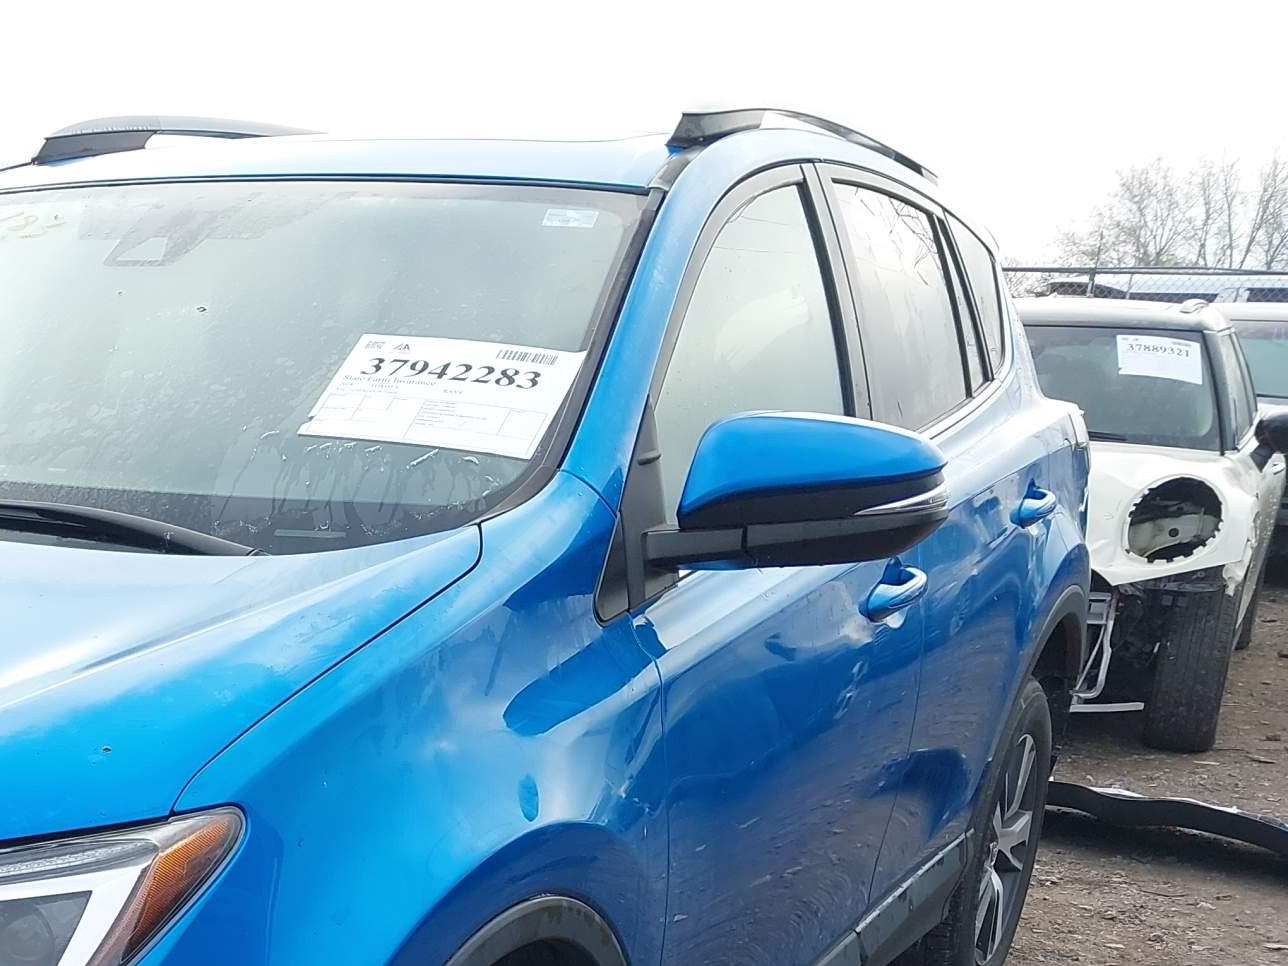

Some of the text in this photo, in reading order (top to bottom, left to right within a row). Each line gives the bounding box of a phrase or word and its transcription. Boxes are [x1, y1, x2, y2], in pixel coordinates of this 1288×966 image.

[1127, 343, 1190, 358] 37889321
[342, 374, 366, 382] State
[359, 357, 543, 390] 37942283
